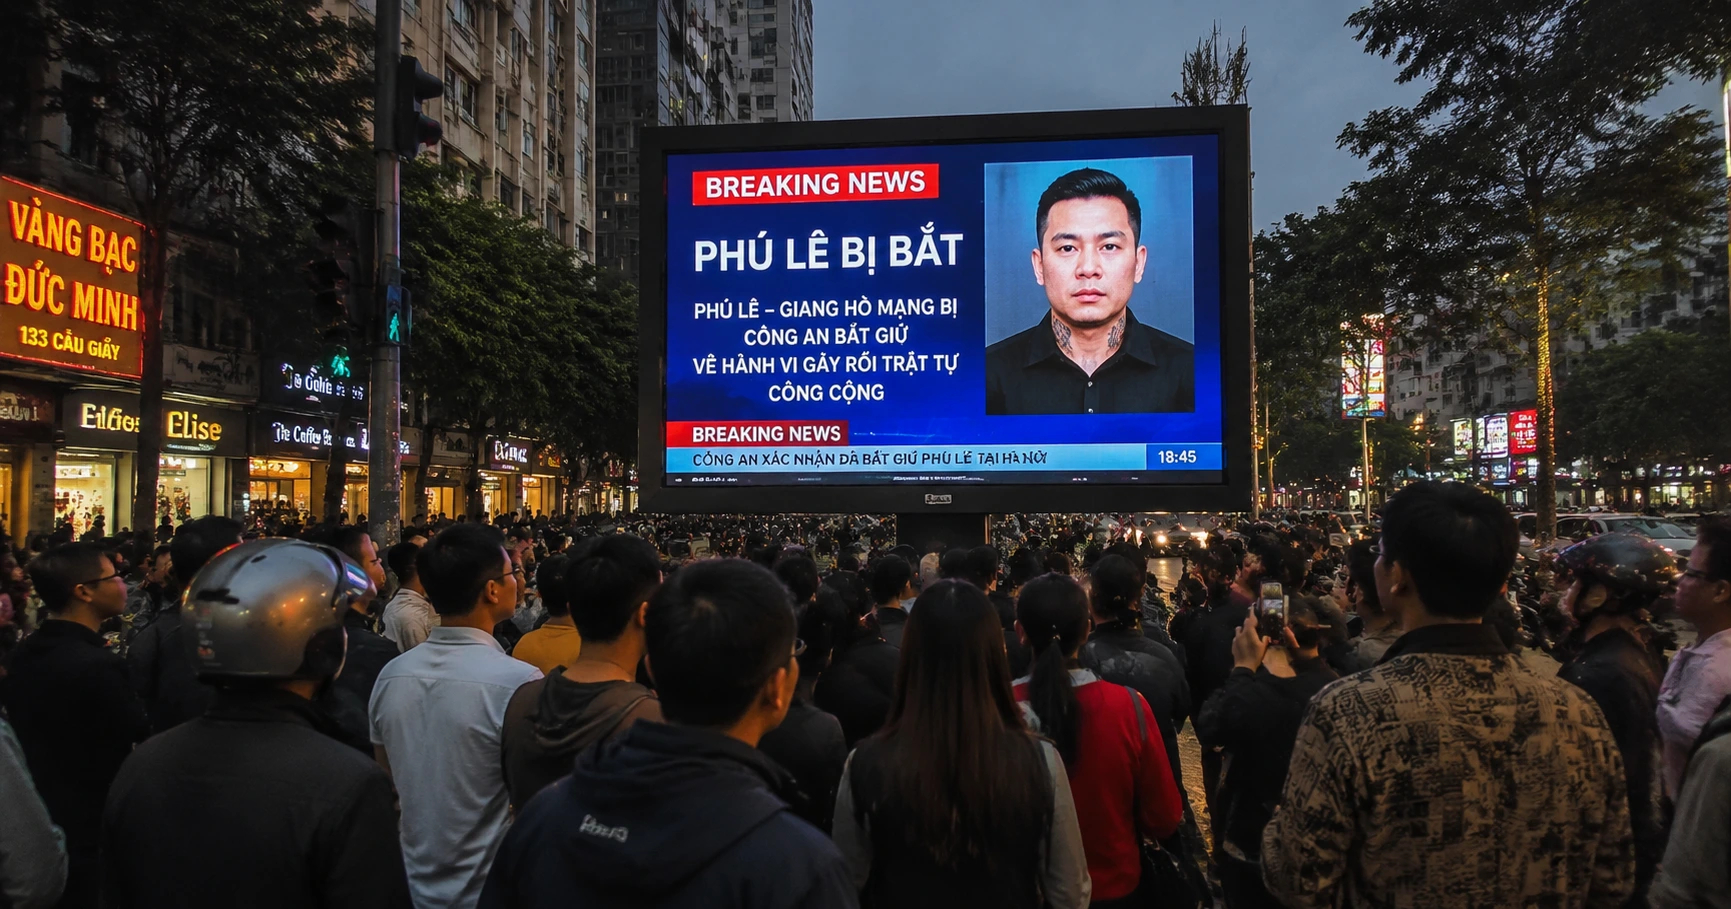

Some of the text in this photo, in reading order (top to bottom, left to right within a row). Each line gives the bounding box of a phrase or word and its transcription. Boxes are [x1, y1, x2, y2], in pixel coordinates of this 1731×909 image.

[707, 171, 925, 197] BREAKING NEWS
[9, 197, 136, 275] VÀNG BẠC
[695, 222, 963, 275] PHÚ LÊ BỊ BẮT
[5, 259, 137, 331] ĐỨC MINH
[695, 298, 732, 319] PHÚ
[739, 298, 759, 318] LÊ
[780, 300, 838, 317] GIANG
[845, 295, 871, 316] HÒ
[878, 298, 934, 319] MẠNG
[941, 298, 957, 318] BỊ
[20, 326, 48, 348] 133
[744, 325, 797, 345] CÔNG
[803, 328, 828, 344] AN
[780, 357, 797, 373] VI
[934, 353, 959, 375] TỰ
[769, 380, 884, 404] CÔNG CỘNG
[167, 411, 222, 441] Elise
[693, 426, 840, 442] BREAKING NEWS
[739, 454, 757, 465] AN
[1159, 451, 1196, 463] 18:45
